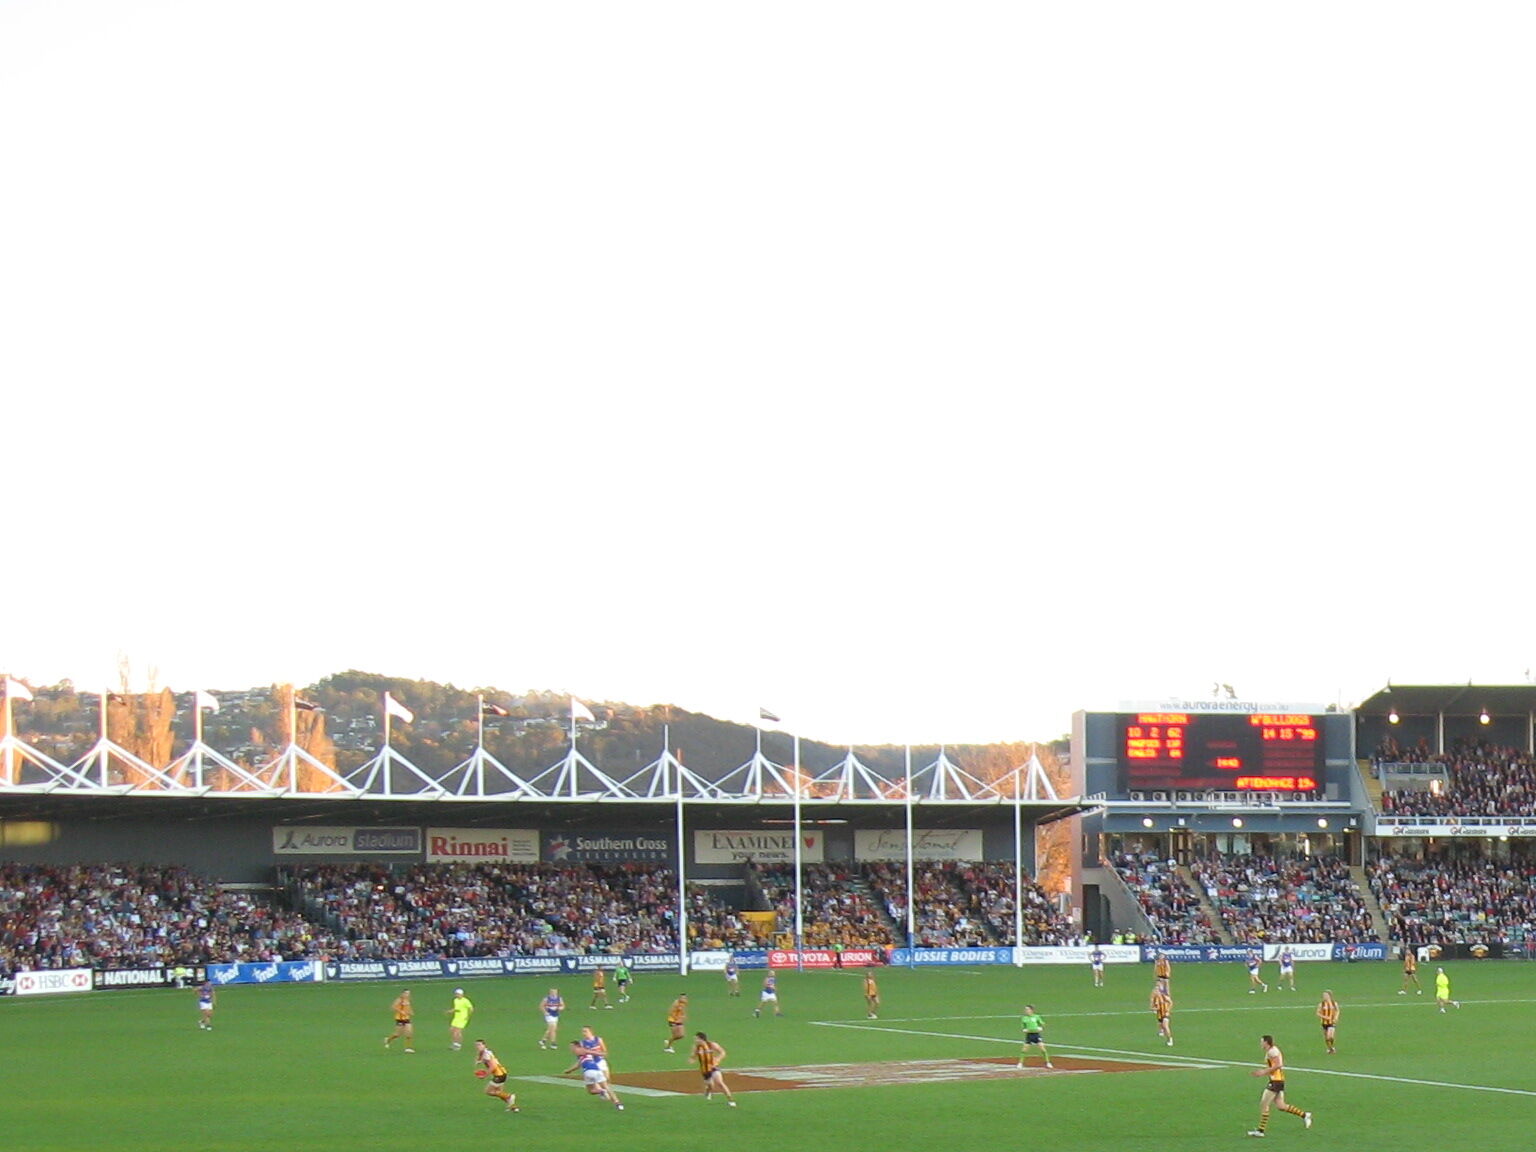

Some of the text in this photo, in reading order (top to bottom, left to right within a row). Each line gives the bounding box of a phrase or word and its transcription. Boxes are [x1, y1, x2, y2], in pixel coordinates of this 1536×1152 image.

[302, 829, 414, 848] Aurora stadium
[576, 837, 667, 850] Southern Cross
[712, 833, 797, 849] EXAMINE
[431, 836, 508, 857] Rinnai
[905, 950, 995, 962] AUSSIE BODIES
[1334, 946, 1382, 958] stdium
[458, 959, 503, 969] TASMANIA
[515, 958, 561, 968] TASMANIA
[578, 955, 622, 966] TASMANIA
[633, 954, 679, 964] TASMANIA
[340, 963, 385, 973] TASMANIA
[398, 961, 441, 971] TASMANIA
[38, 974, 70, 989] HSBC
[105, 969, 164, 985] NATIONAL
